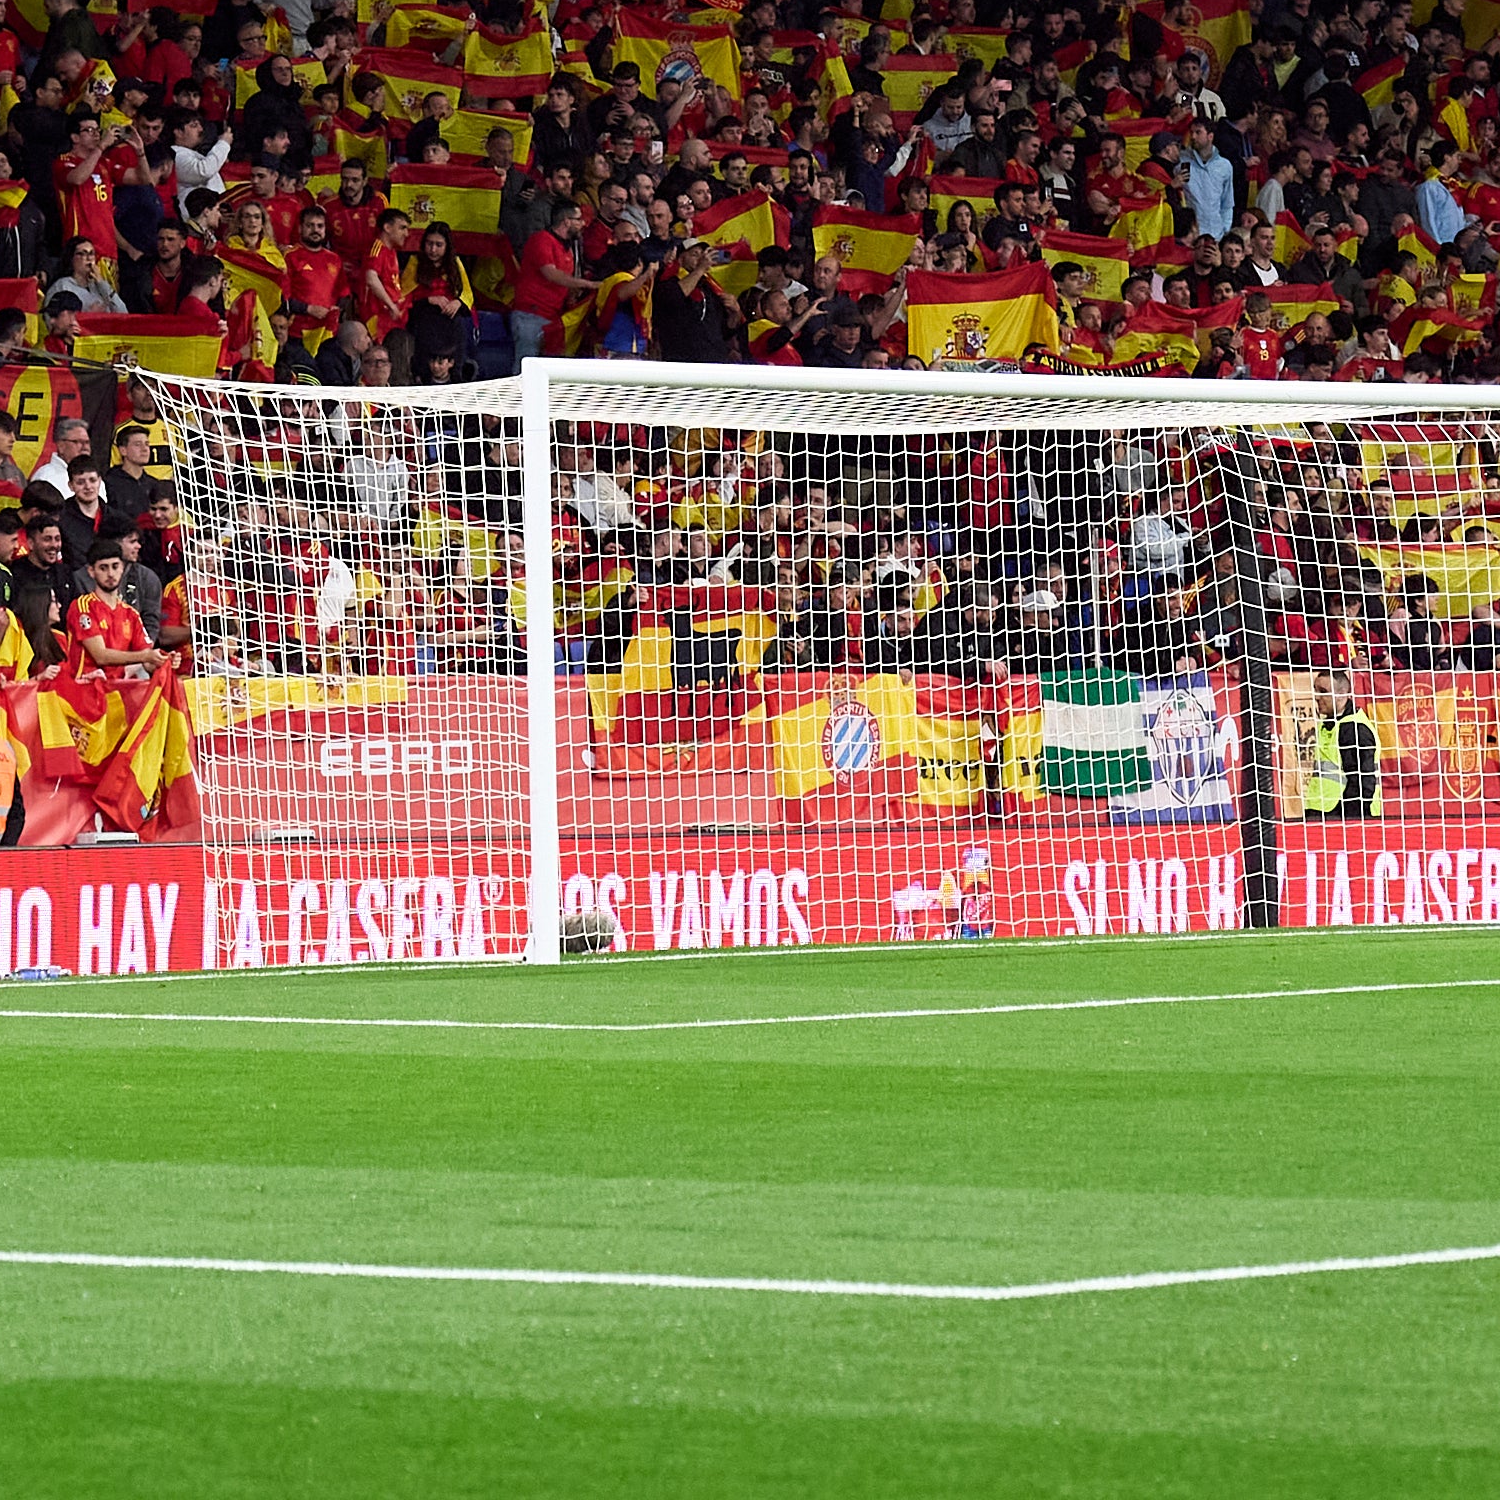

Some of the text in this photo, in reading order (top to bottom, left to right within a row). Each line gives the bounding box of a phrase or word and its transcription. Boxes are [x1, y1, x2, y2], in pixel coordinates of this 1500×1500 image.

[93, 184, 108, 202] 16
[320, 739, 474, 777] EBRO
[1064, 858, 1107, 936] SI
[1128, 857, 1188, 935] NO
[79, 882, 179, 978] HAY
